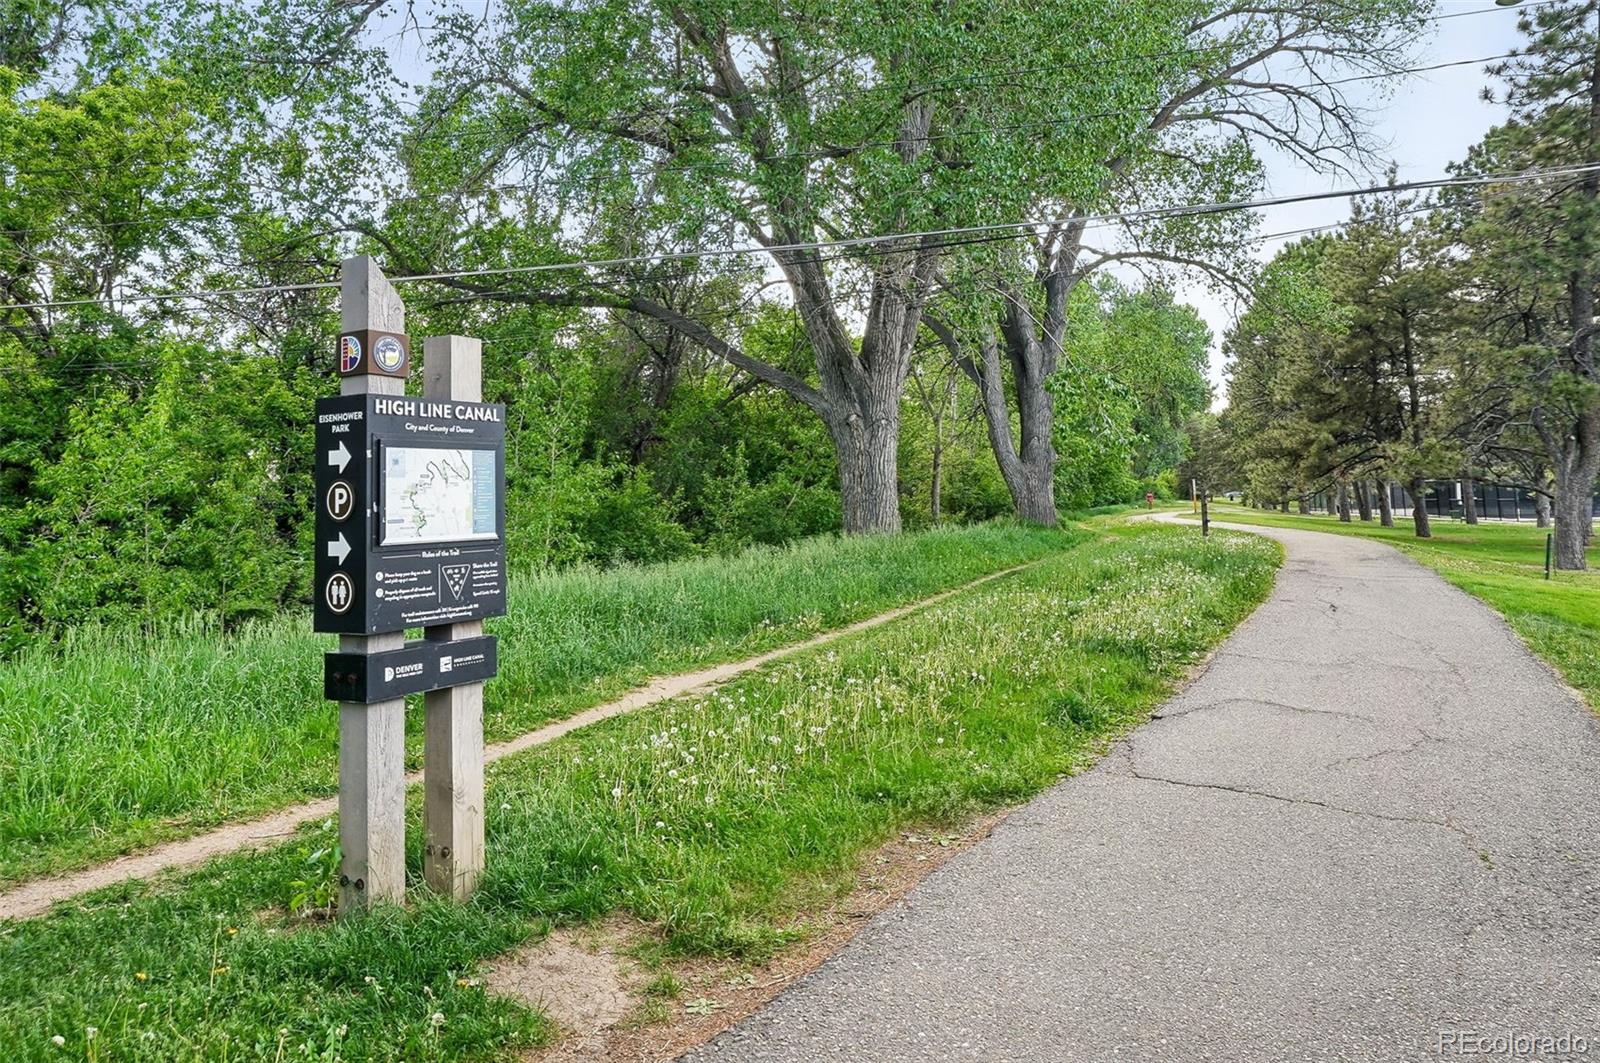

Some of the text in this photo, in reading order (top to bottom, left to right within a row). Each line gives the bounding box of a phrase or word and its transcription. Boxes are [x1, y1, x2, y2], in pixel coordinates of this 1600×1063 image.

[375, 399, 500, 422] HIGH LINE CANAL
[319, 411, 363, 423] EISENHOWER
[331, 424, 350, 433] PARK
[405, 422, 418, 433] City
[429, 424, 449, 435] County
[334, 488, 348, 514] P
[450, 548, 460, 556] Trail
[395, 663, 423, 674] DENVER
